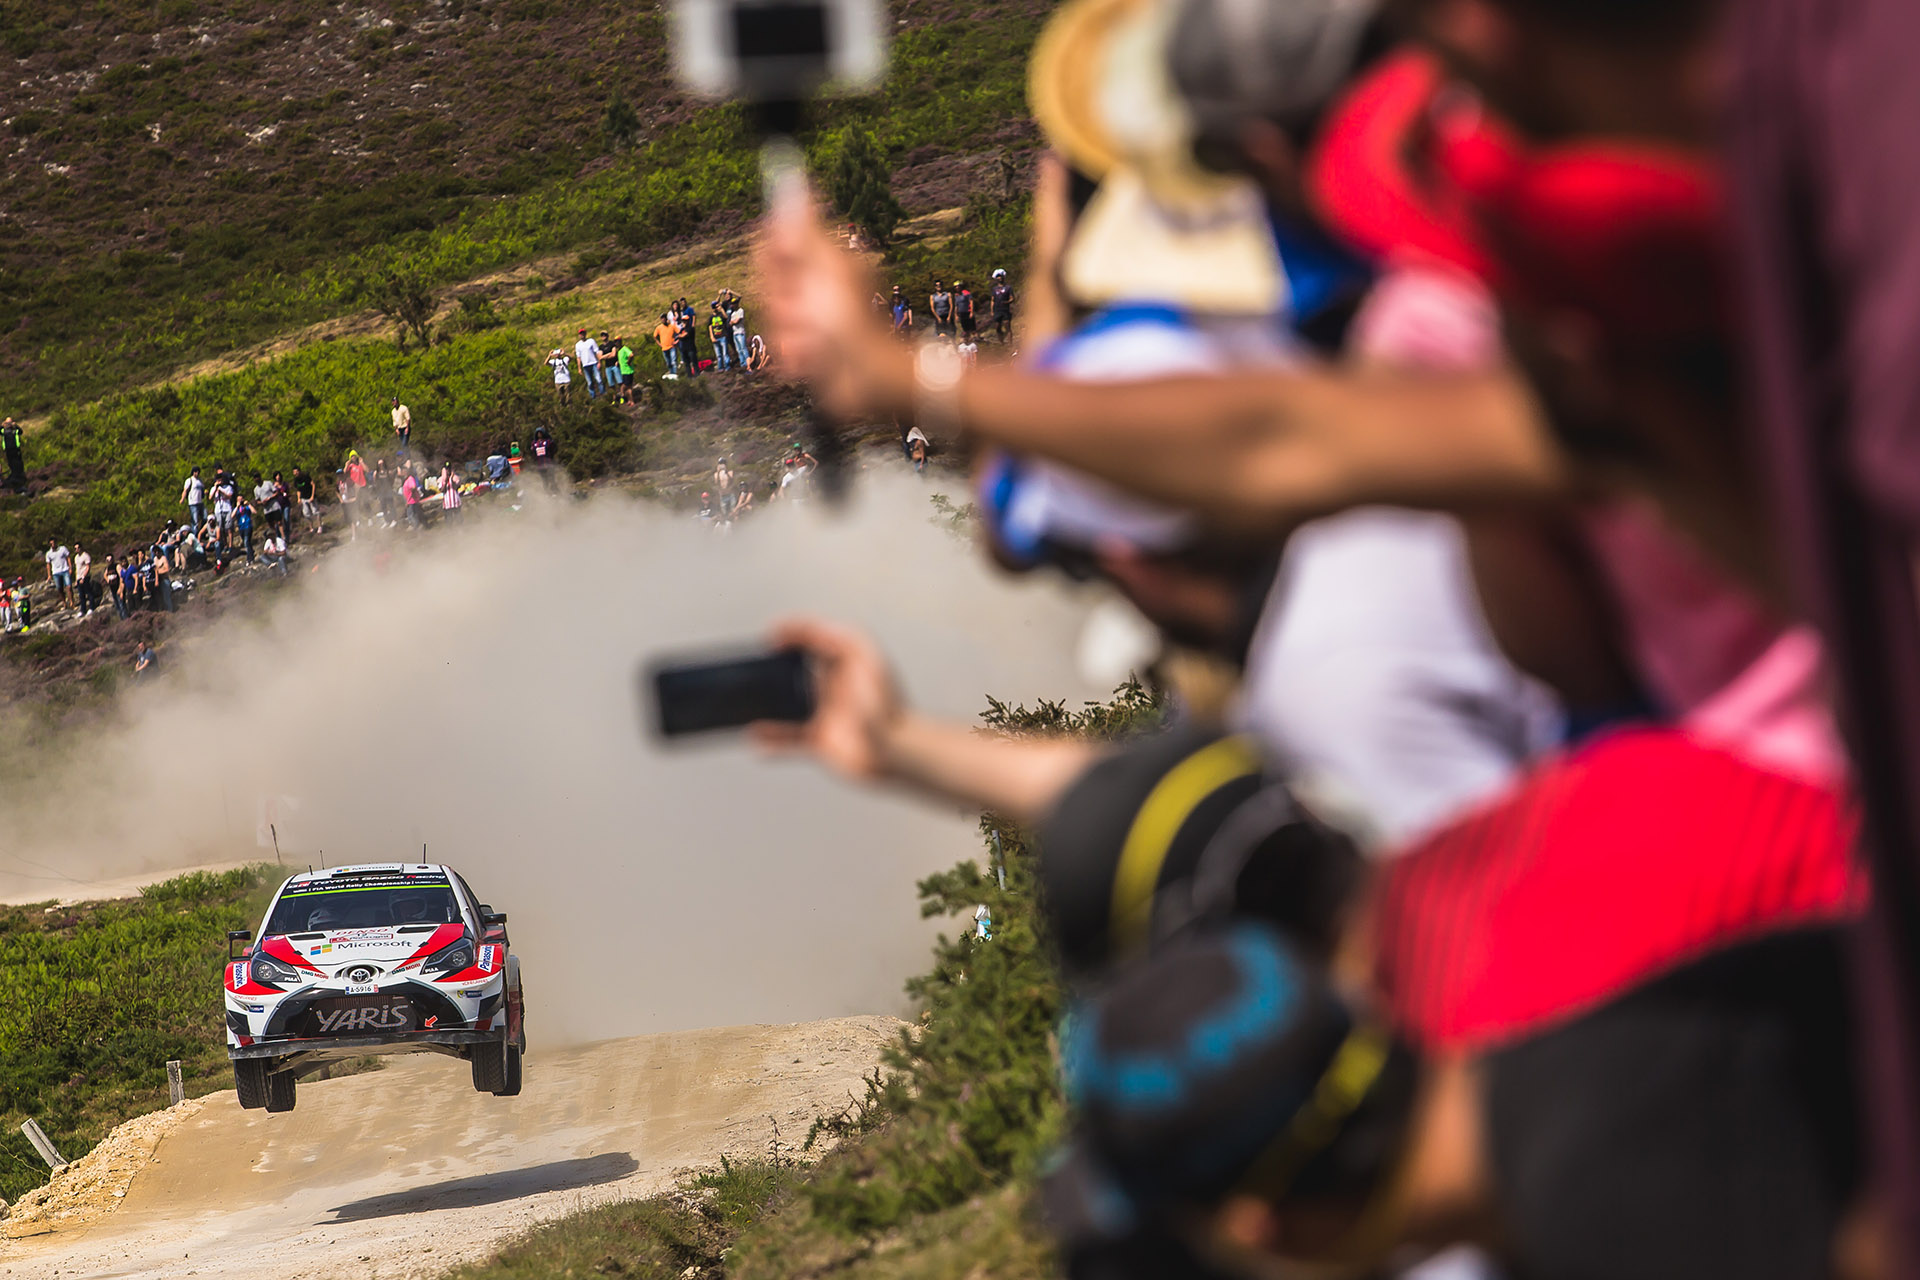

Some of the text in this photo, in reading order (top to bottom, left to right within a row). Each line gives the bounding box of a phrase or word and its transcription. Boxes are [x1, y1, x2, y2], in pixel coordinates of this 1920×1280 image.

[313, 878, 359, 886] TOYOTA
[336, 928, 388, 936] DENSO
[338, 940, 413, 950] Microsoft
[479, 946, 492, 971] Panason
[392, 962, 422, 976] DMG MORI
[300, 969, 329, 980] DMG MORI
